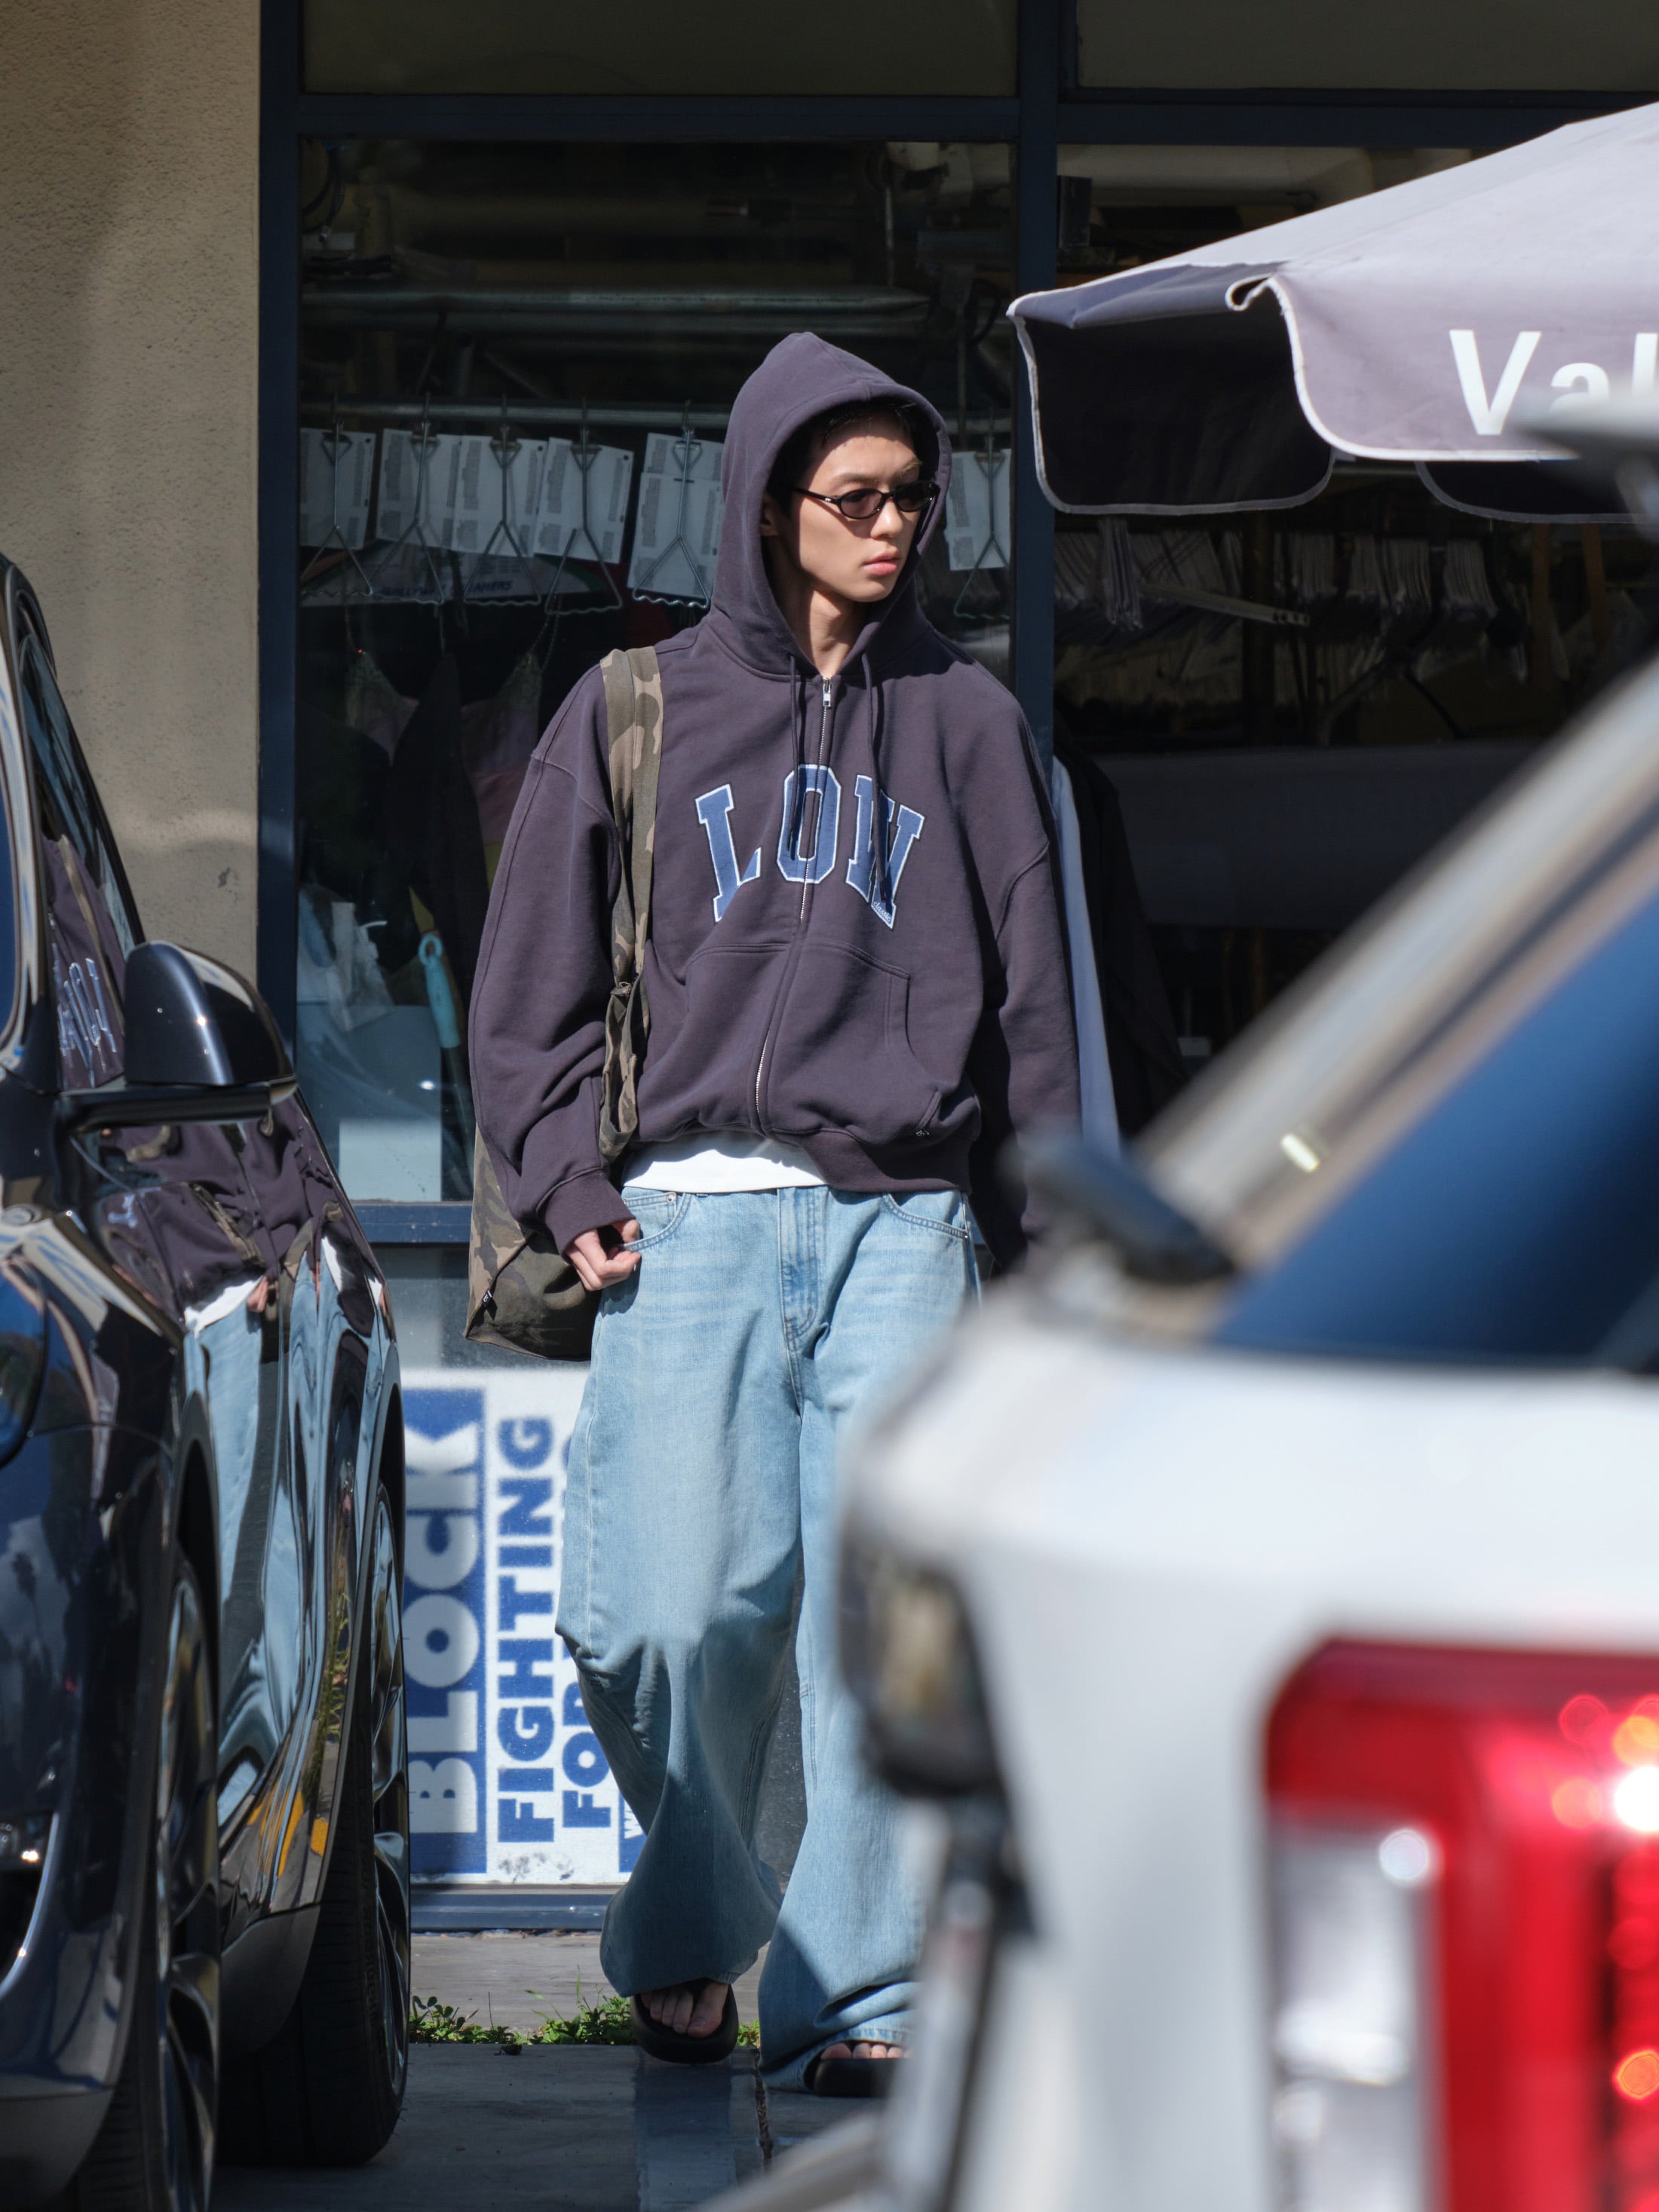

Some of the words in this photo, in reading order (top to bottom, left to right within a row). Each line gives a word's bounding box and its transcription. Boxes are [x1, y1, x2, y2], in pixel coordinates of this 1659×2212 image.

[695, 763, 925, 930] LOW
[401, 1422, 480, 1834] BLOCK
[497, 1417, 554, 1843] FIGHTING
